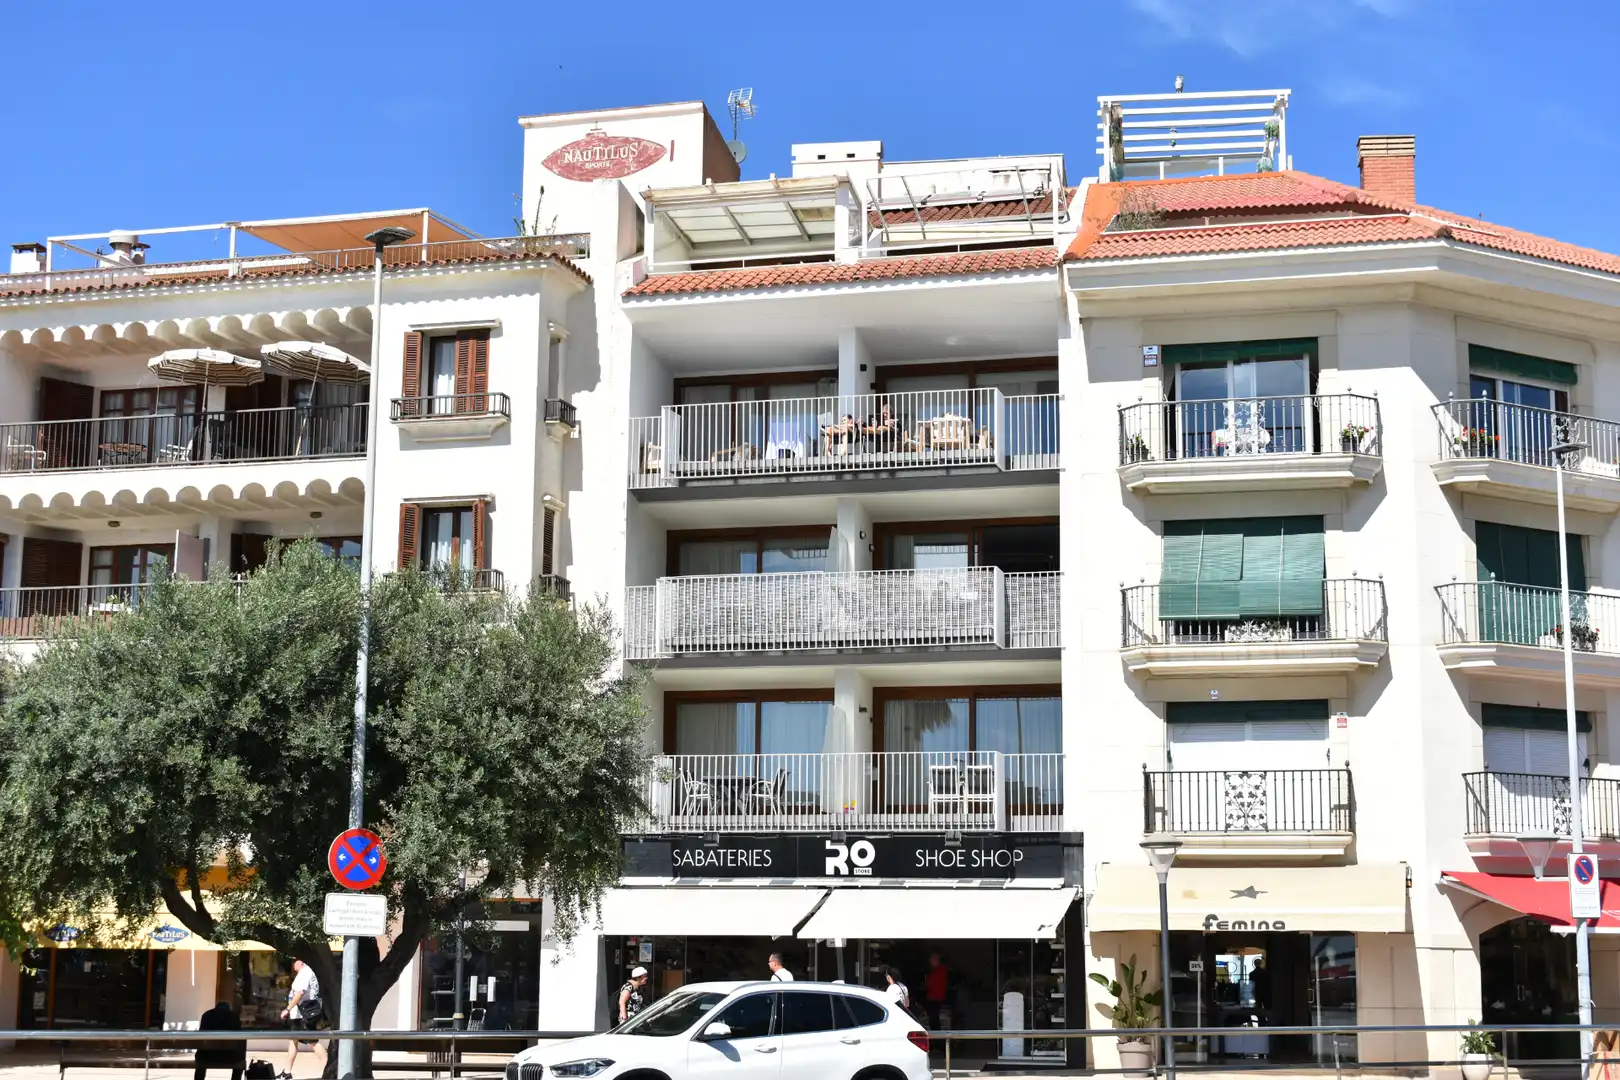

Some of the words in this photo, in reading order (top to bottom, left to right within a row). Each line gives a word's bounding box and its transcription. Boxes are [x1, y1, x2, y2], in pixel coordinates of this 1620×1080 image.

[564, 143, 638, 163] NAUTILUS
[672, 849, 772, 867] SABATERIES
[825, 840, 876, 876] RO
[915, 849, 966, 867] SHOE
[971, 849, 1024, 867] SHOP
[1202, 914, 1286, 931] femina
